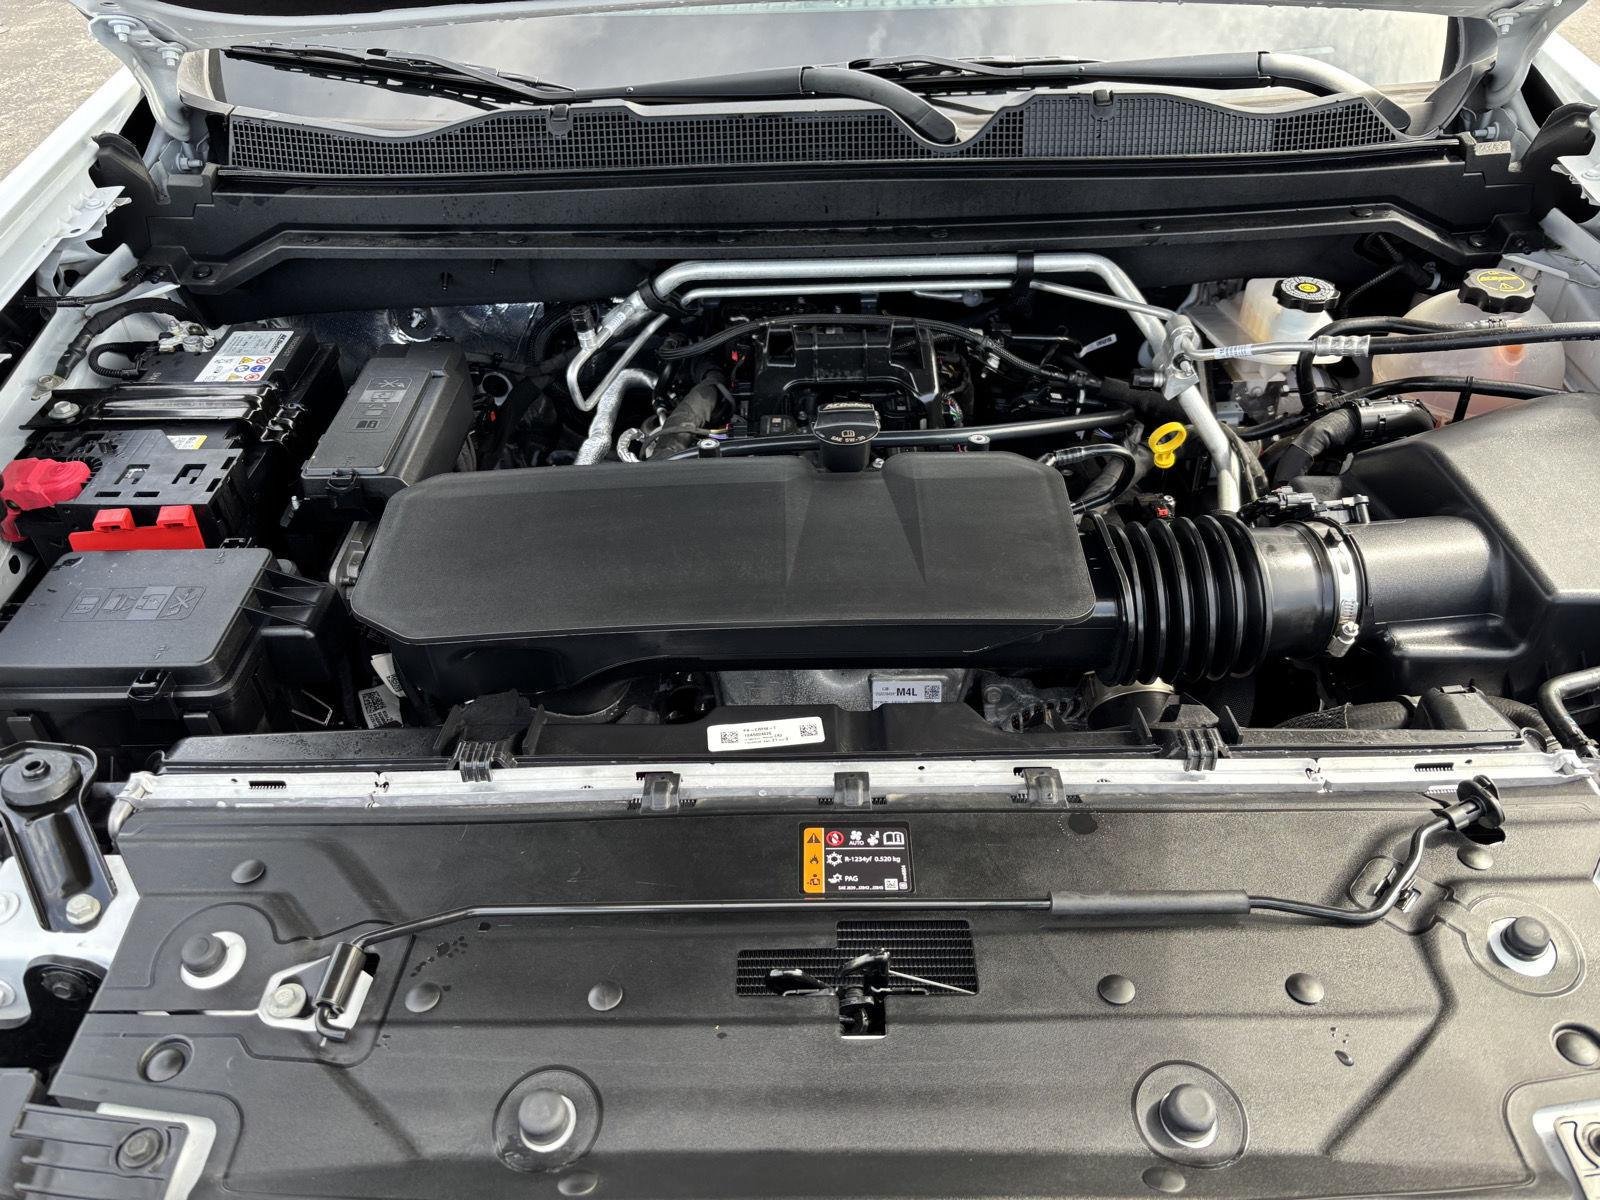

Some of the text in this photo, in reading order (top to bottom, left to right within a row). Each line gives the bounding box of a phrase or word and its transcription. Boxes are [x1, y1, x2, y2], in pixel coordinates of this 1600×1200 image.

[896, 687, 918, 697] M4L
[844, 855, 901, 864] R-1234yf 0.520 kg
